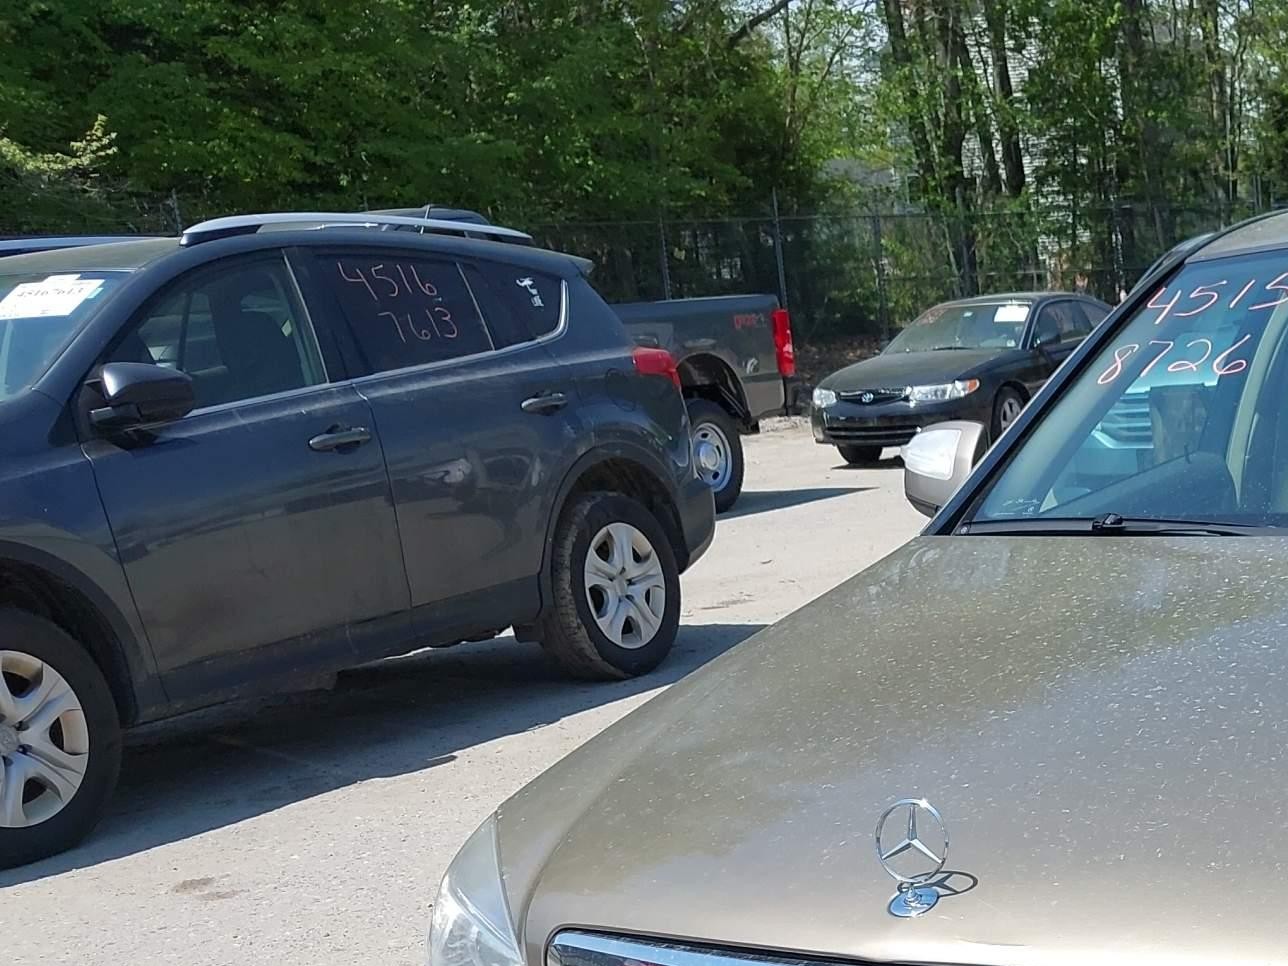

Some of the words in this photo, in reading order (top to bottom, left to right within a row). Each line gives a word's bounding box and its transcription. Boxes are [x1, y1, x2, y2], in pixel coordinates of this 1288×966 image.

[337, 262, 437, 300] 4516
[378, 307, 458, 343] 7613
[1097, 334, 1251, 385] 8726
